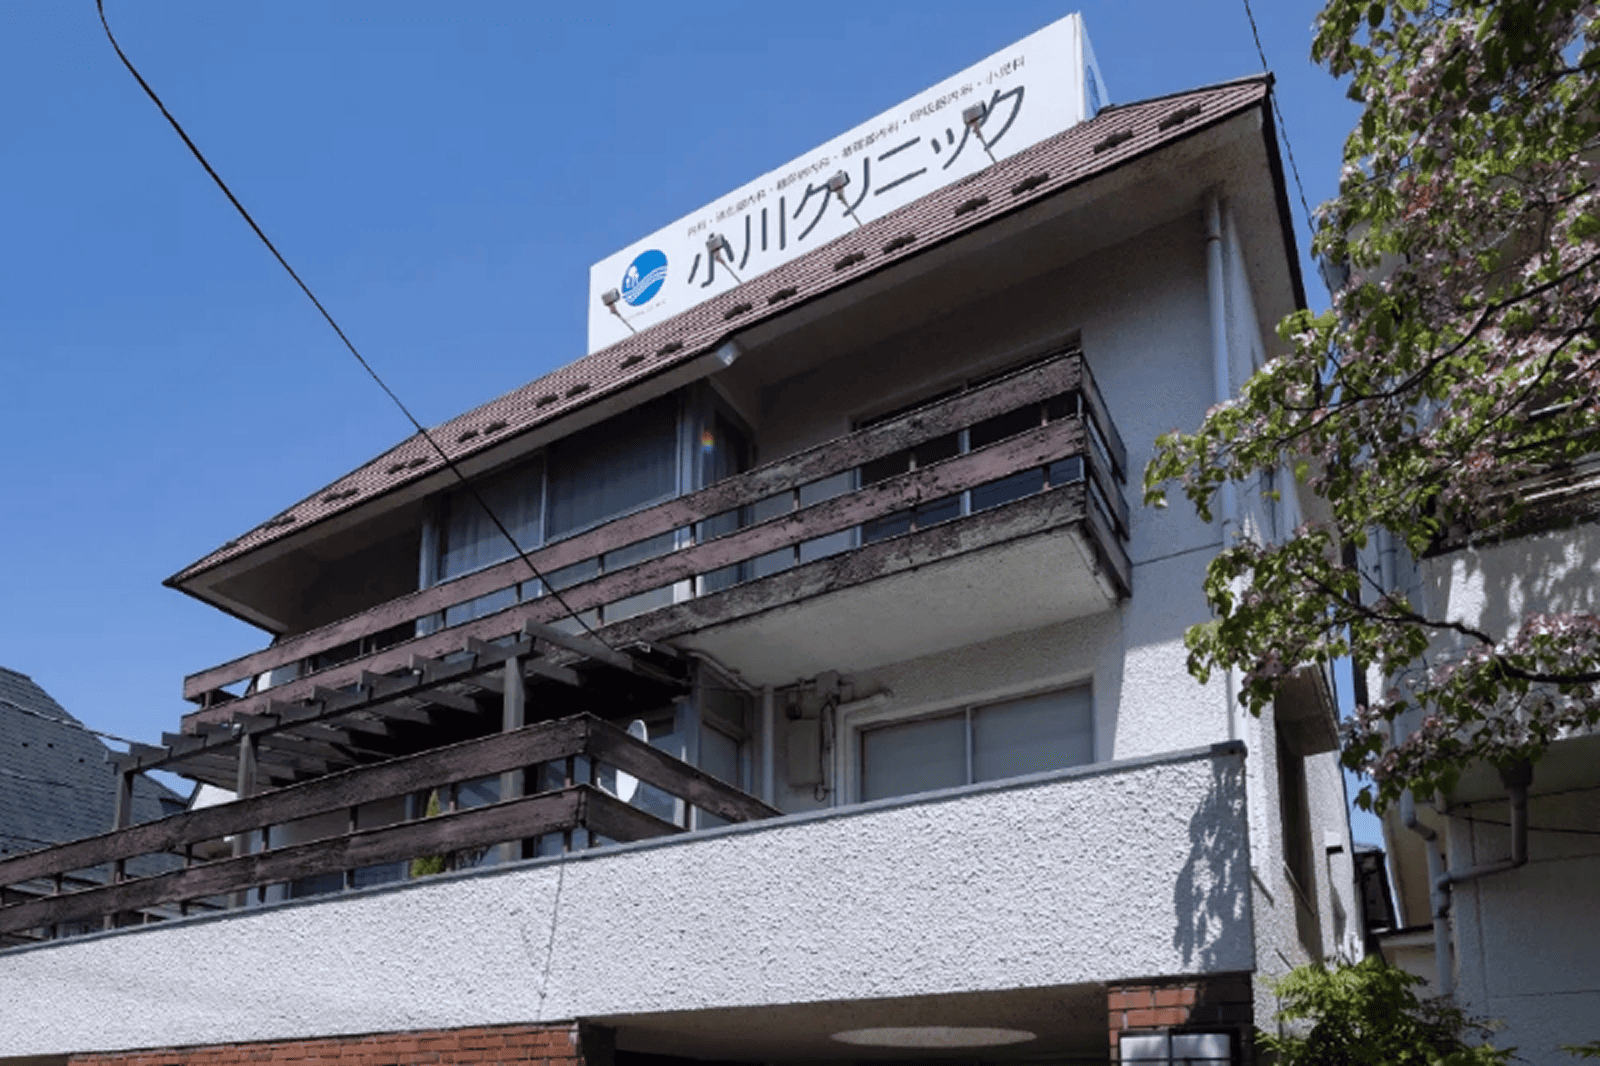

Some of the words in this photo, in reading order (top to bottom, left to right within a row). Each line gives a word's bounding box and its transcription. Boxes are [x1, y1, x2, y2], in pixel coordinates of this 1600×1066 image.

[687, 85, 1025, 288] 小川クリニック
